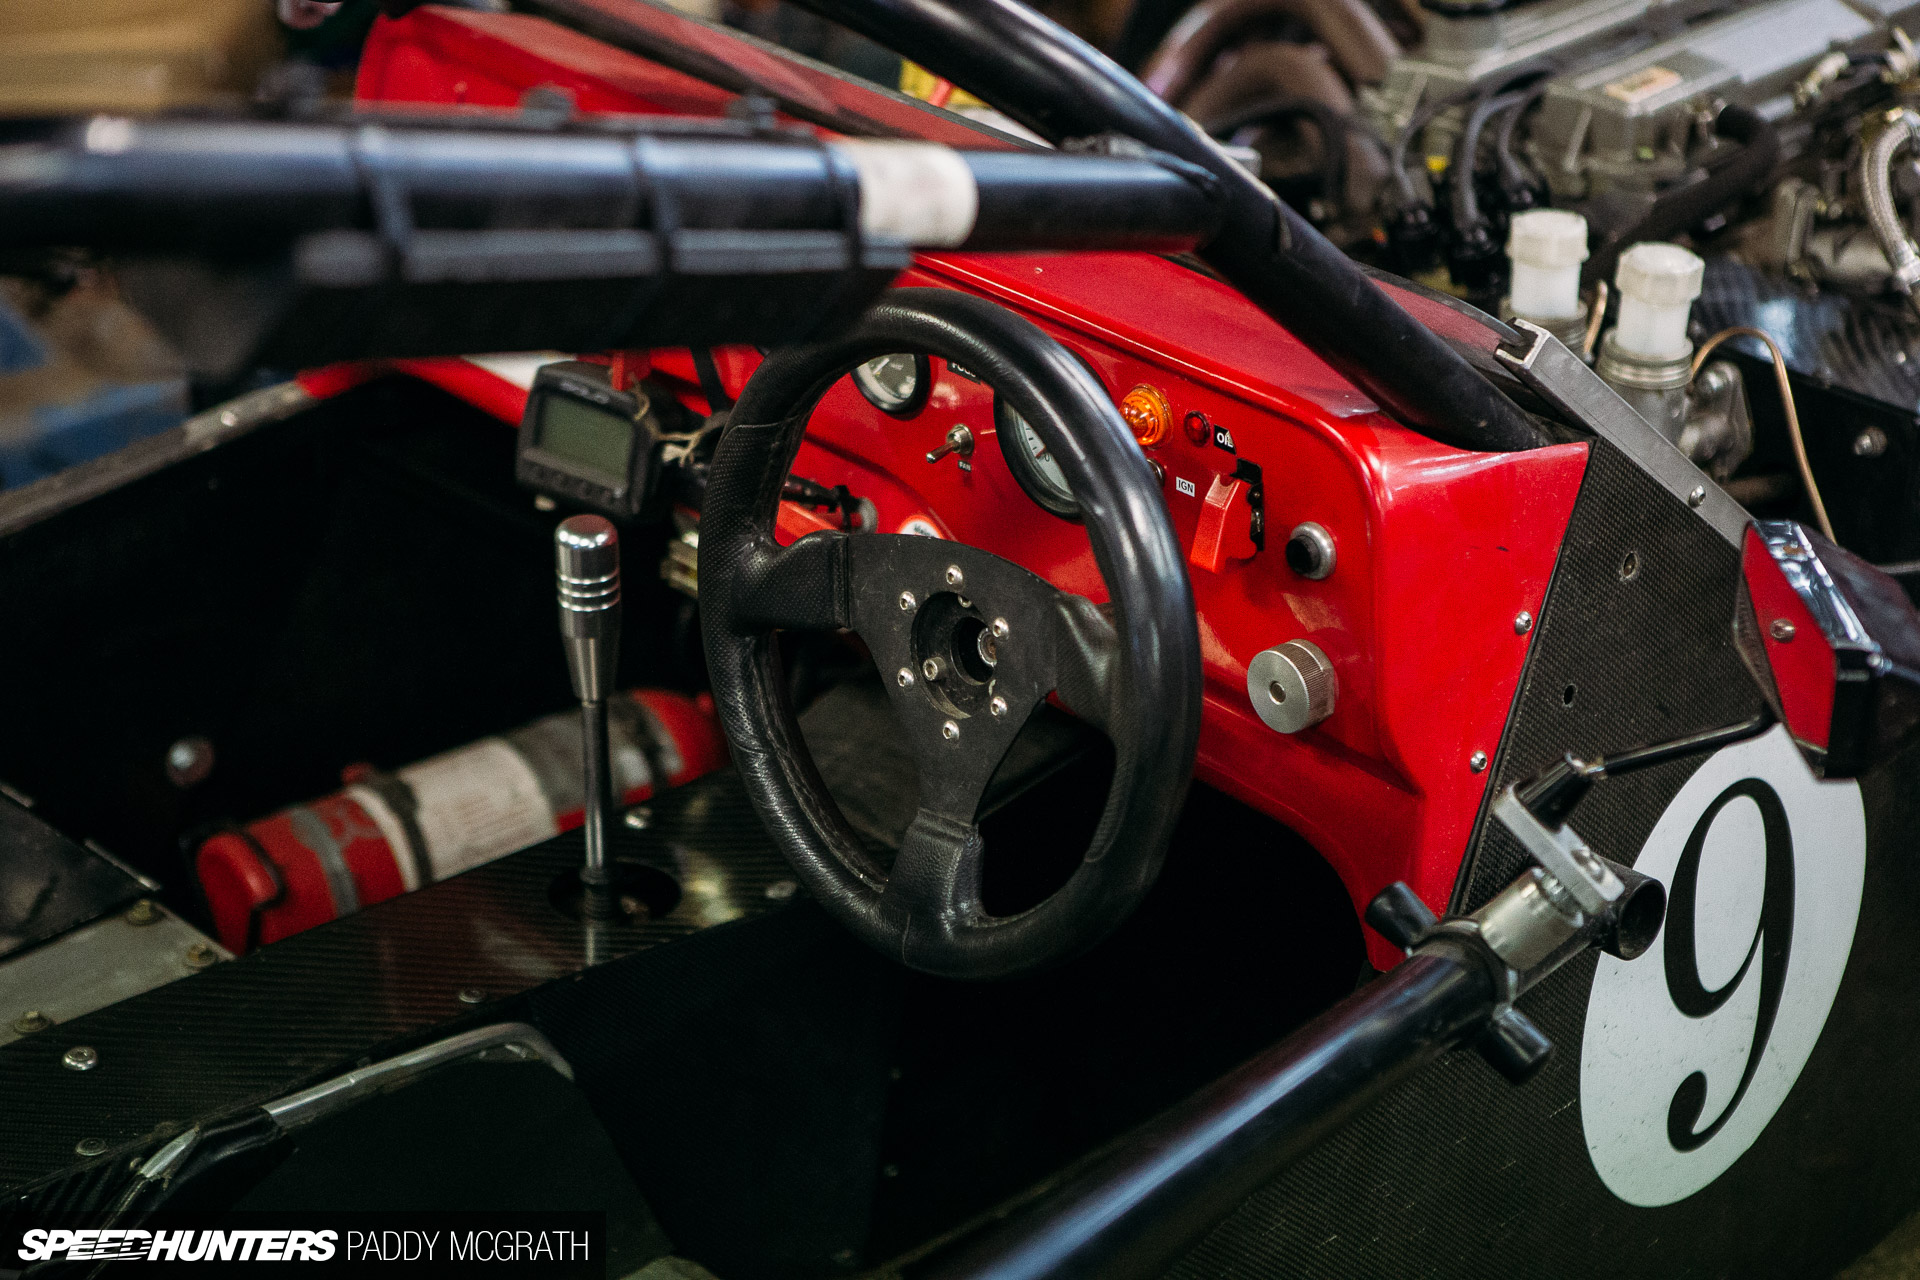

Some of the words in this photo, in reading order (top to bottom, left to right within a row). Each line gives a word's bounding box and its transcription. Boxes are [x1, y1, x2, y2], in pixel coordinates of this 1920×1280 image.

[1216, 432, 1234, 449] OIL
[1178, 479, 1194, 493] IGN
[1664, 778, 1796, 1153] 9
